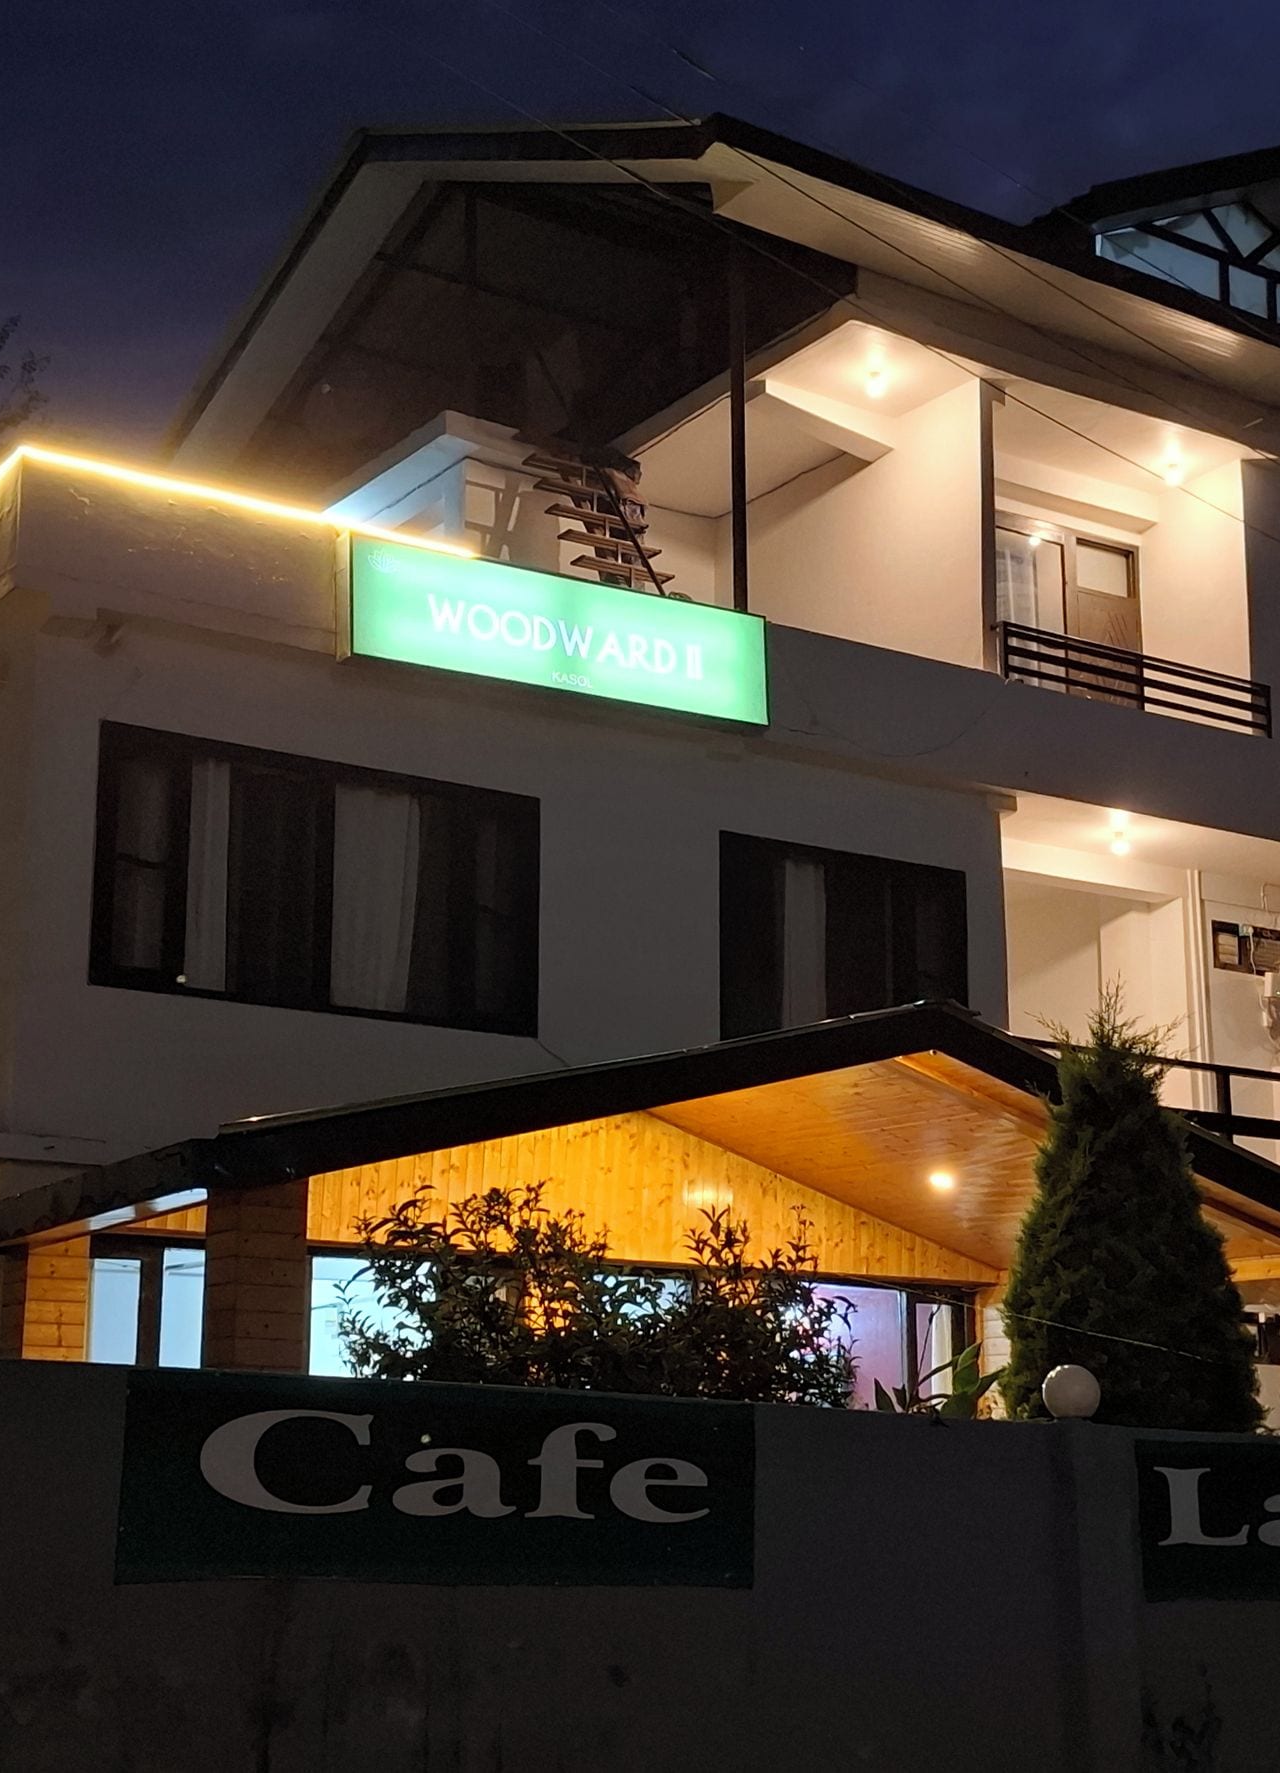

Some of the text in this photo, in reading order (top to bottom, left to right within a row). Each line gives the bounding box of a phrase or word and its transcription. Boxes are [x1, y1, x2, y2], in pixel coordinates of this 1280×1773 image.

[427, 593, 677, 675] WOODWARD
[551, 671, 593, 689] KASOL
[199, 1408, 711, 1524] Cafe
